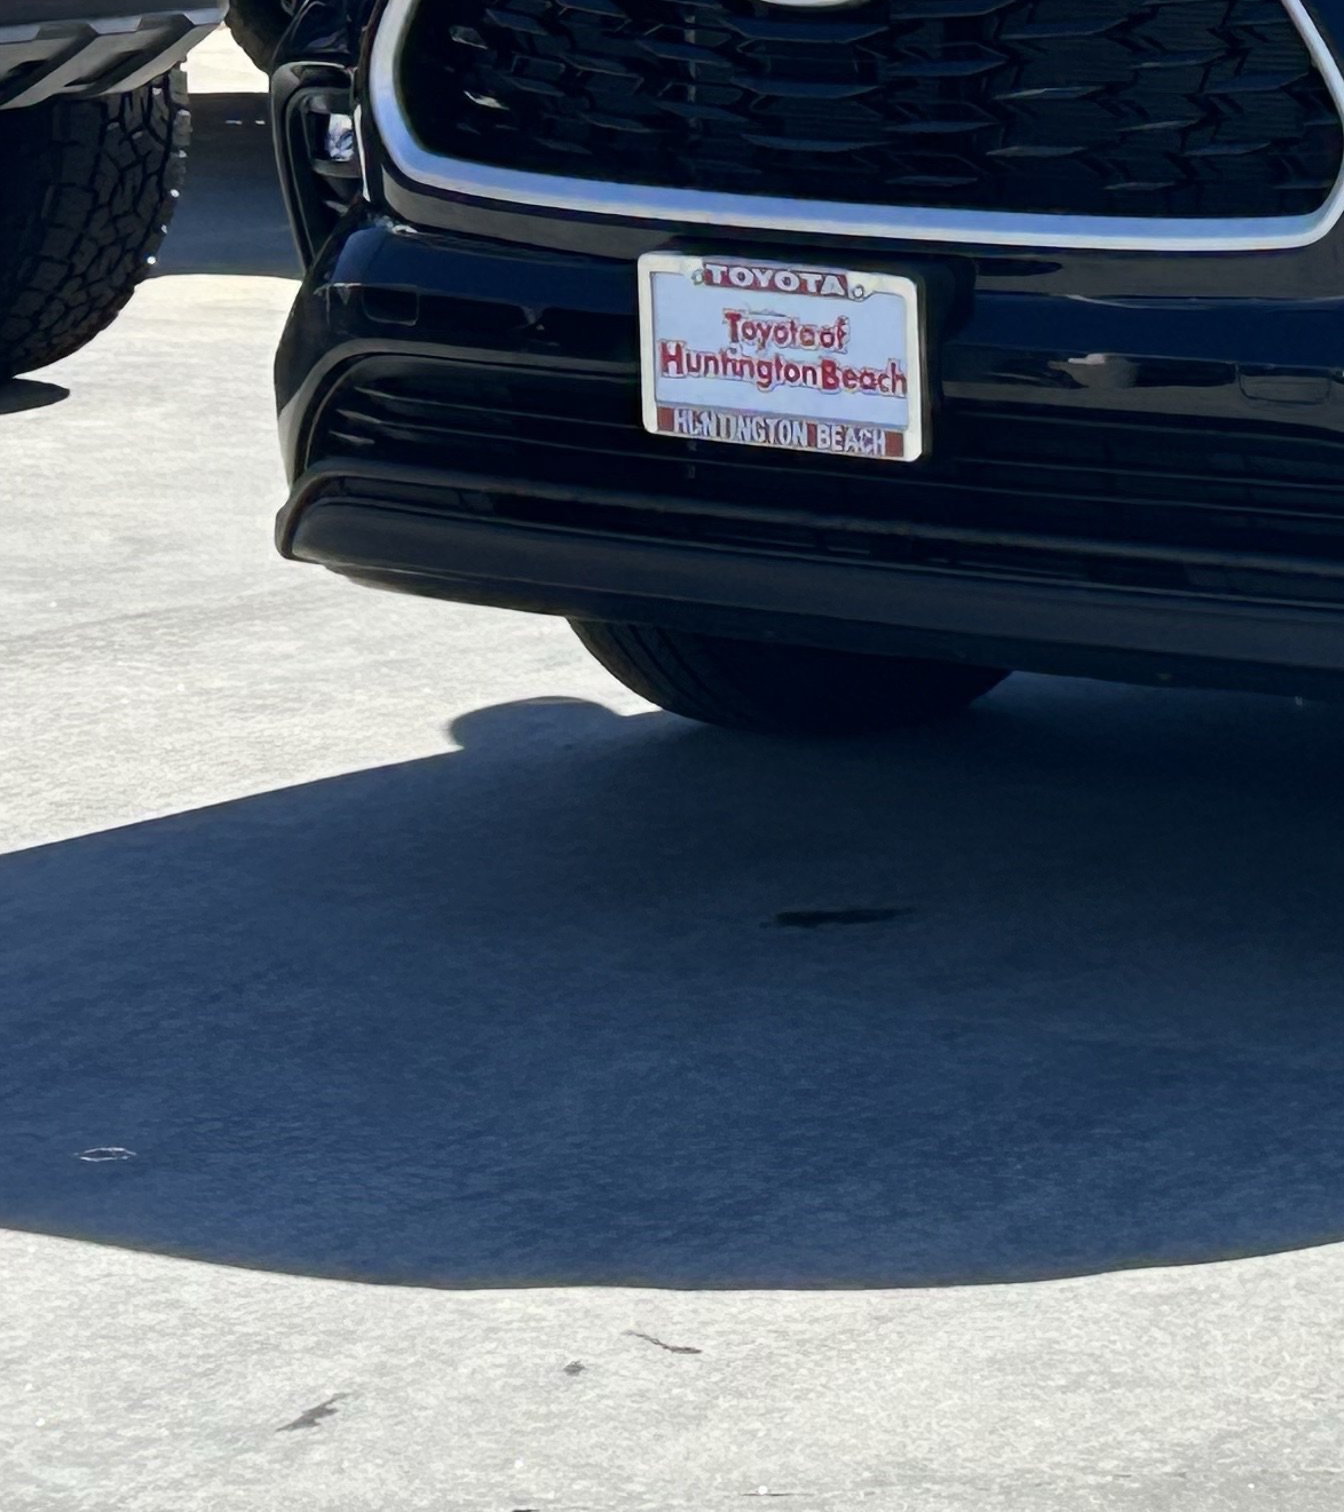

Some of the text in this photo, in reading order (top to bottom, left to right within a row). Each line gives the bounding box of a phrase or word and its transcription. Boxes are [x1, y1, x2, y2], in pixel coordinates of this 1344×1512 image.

[703, 263, 846, 297] TOYOTA
[724, 308, 849, 354] Toyota of
[657, 339, 908, 397] Huntington Beach
[817, 424, 886, 456] BEACH
